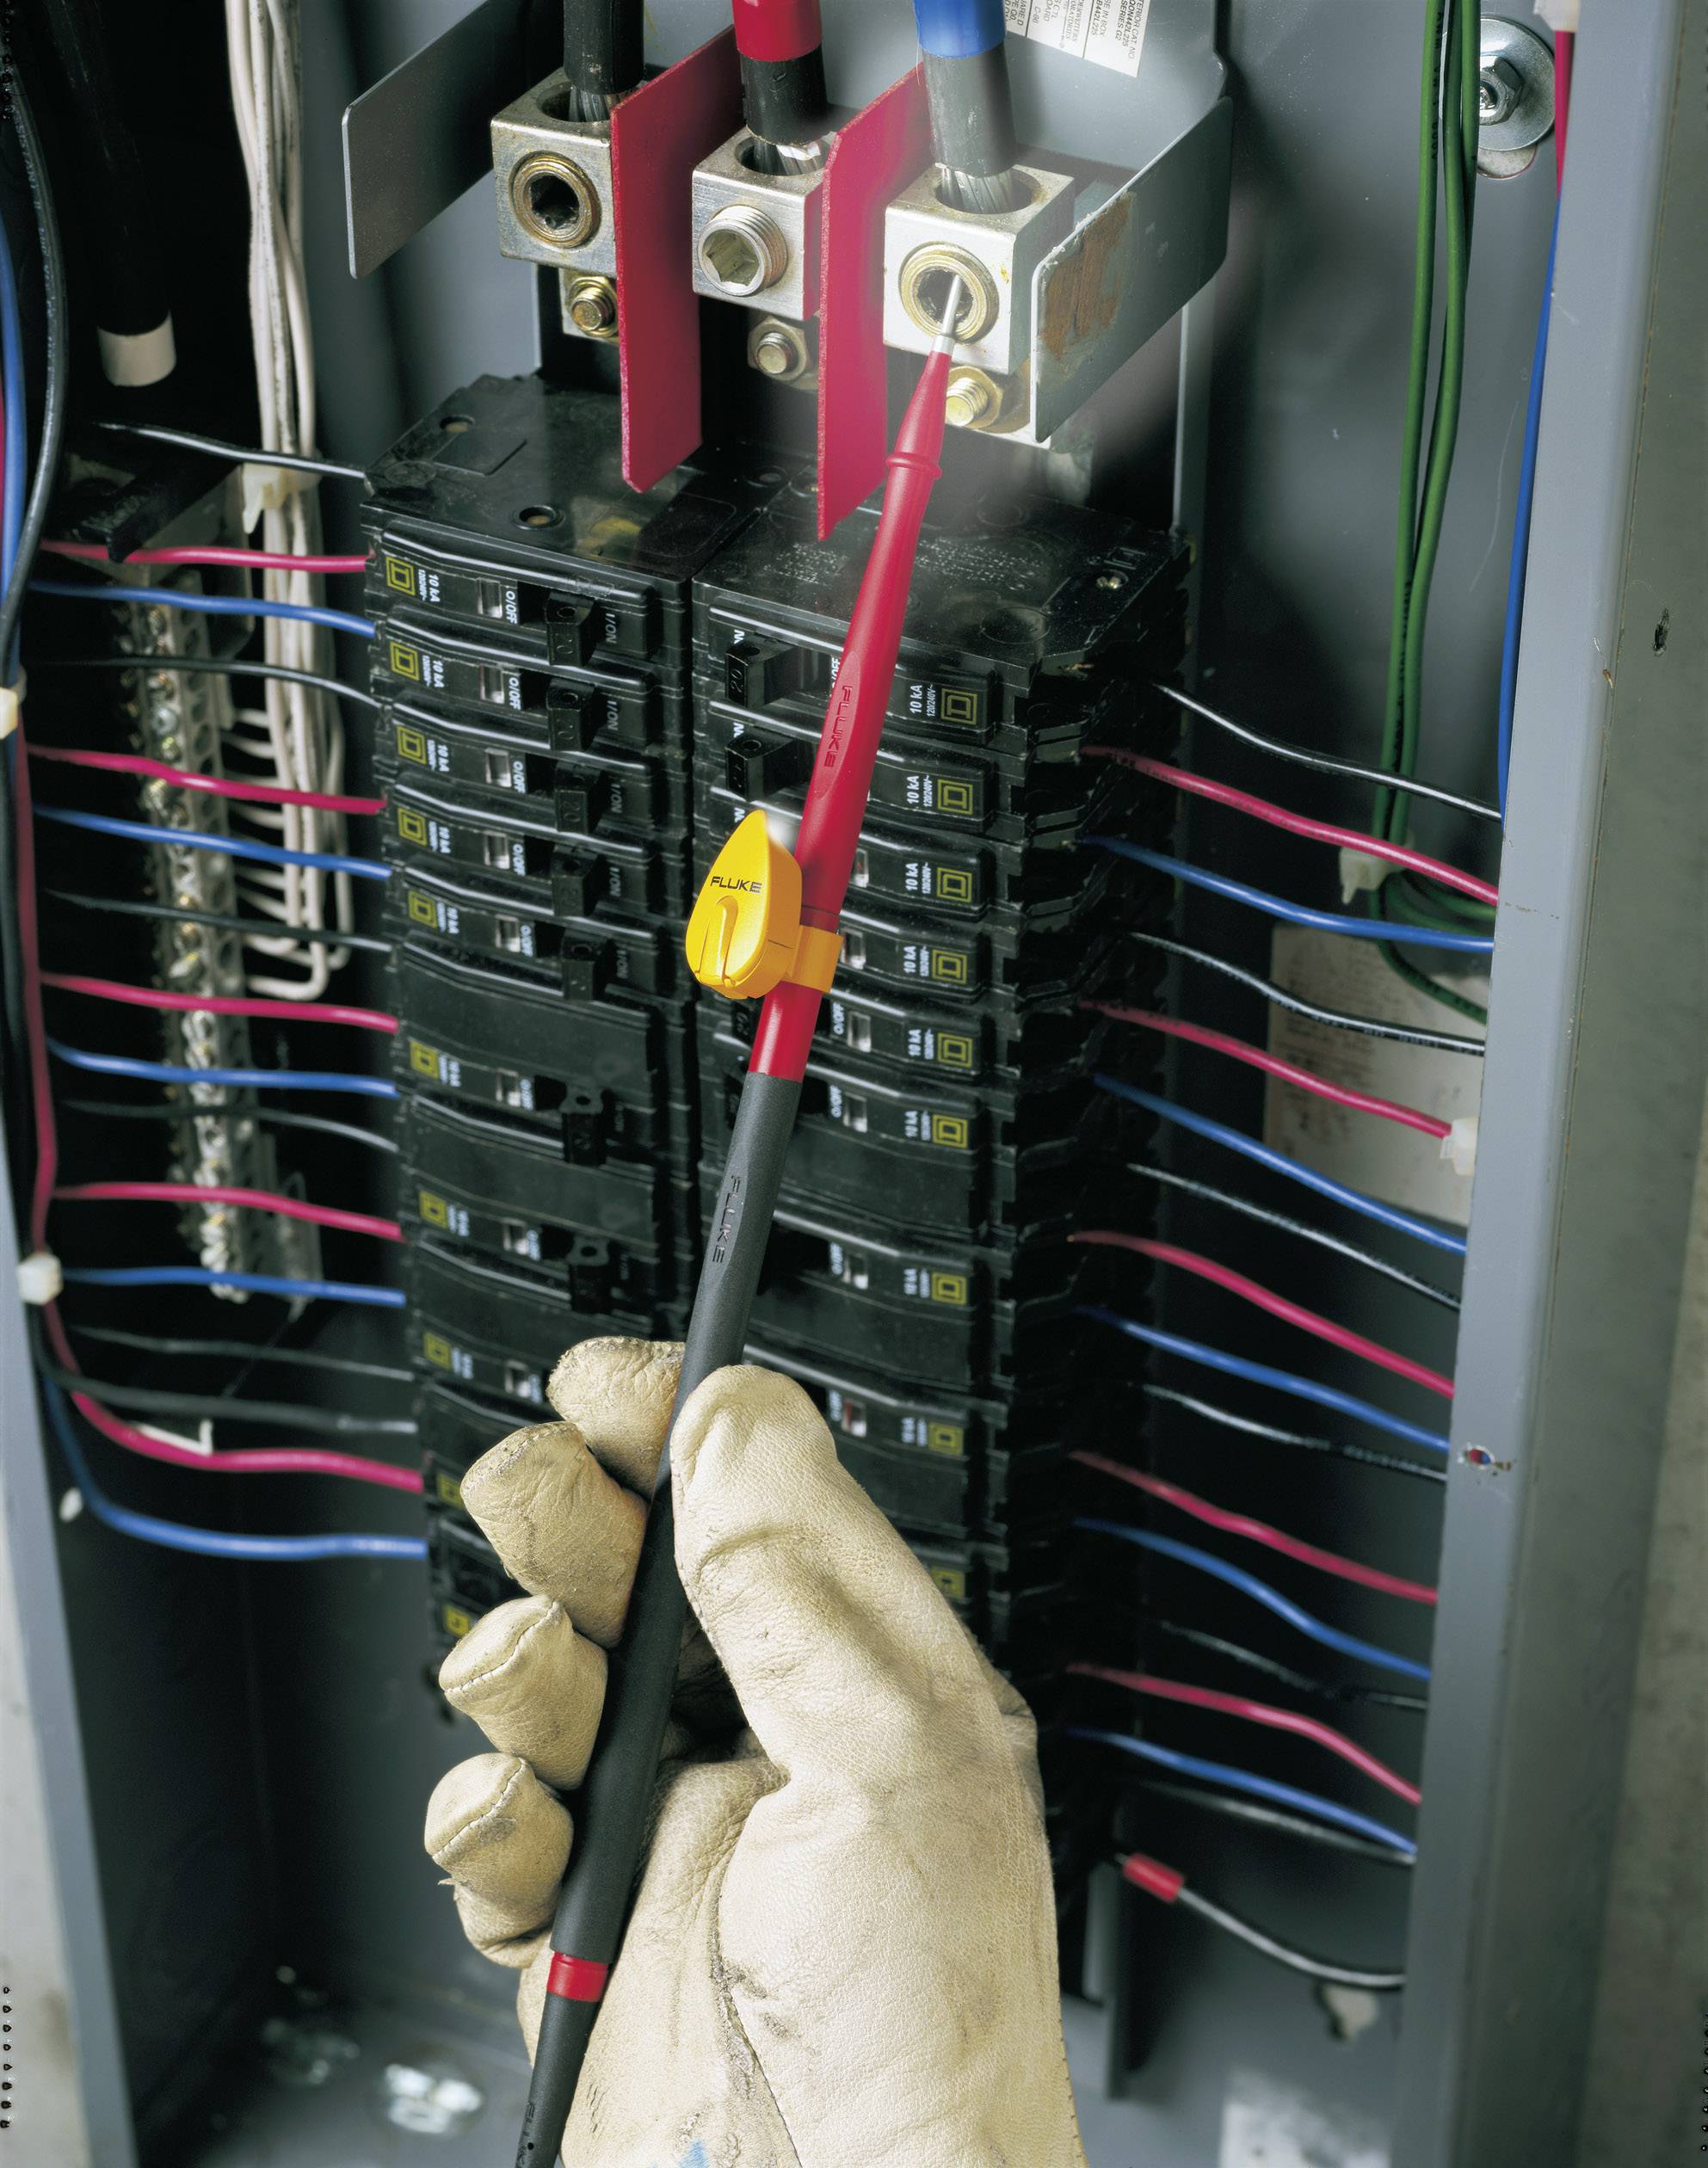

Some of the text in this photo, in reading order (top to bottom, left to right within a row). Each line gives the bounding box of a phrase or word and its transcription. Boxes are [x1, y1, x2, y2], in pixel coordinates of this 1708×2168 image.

[1118, 0, 1128, 28] SERIES
[506, 590, 519, 625] O/OFF
[509, 677, 521, 711] O/OFF
[824, 685, 853, 767] FLUKE
[513, 761, 527, 794] O/OFF
[711, 876, 762, 894] FLUKE
[712, 1175, 741, 1263] FLUKE
